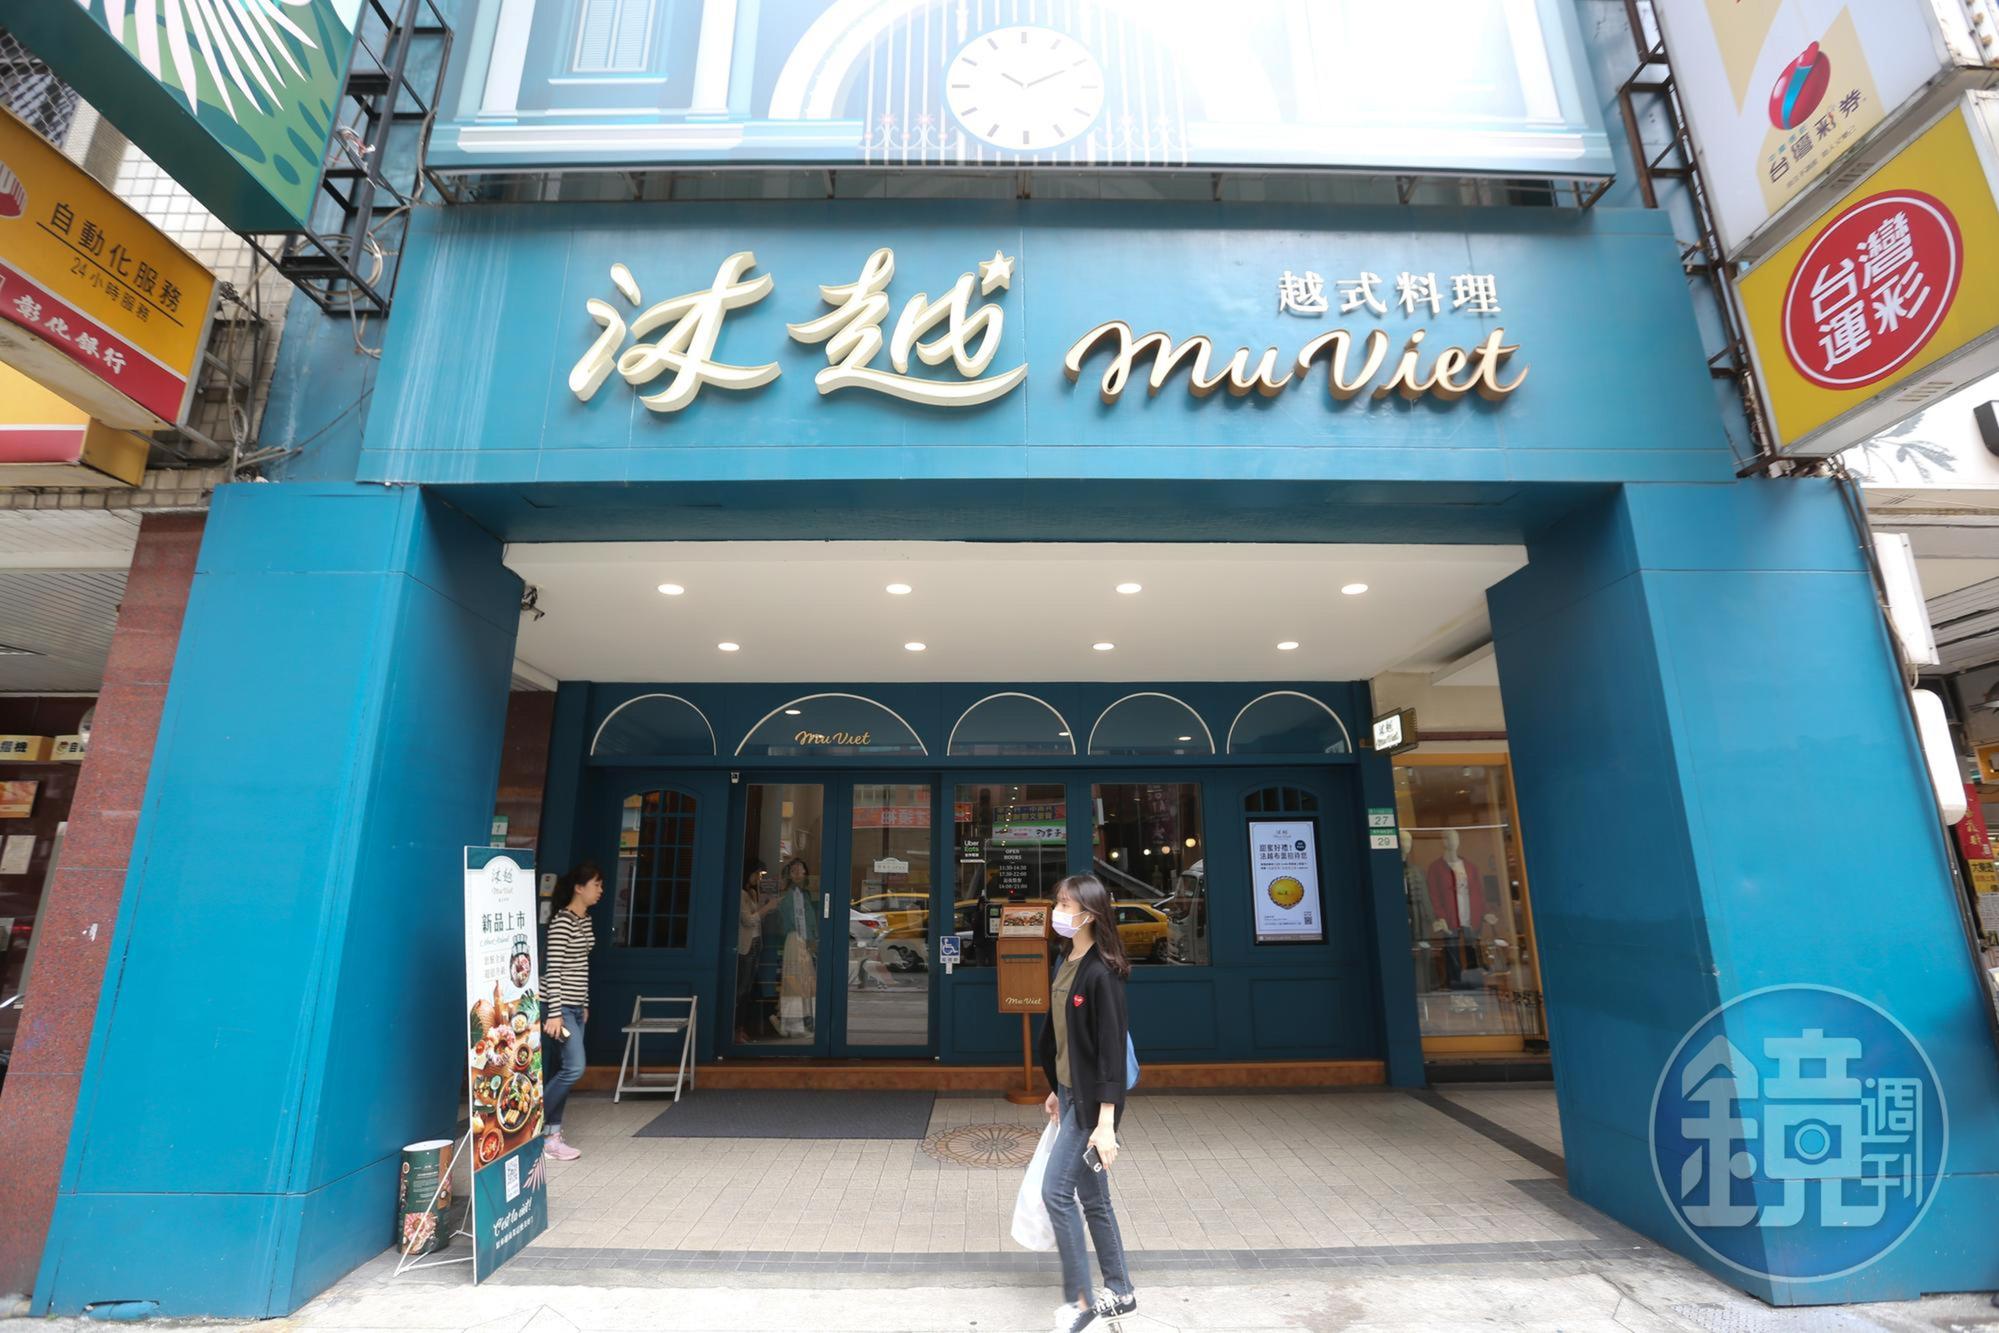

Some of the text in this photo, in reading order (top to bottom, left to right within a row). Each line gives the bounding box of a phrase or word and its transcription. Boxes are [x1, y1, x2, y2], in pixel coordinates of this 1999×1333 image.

[1768, 89, 1862, 184] 台灣彩券
[50, 203, 183, 313] 自動化服務
[70, 257, 151, 323] 24小時服務
[1277, 270, 1508, 317] 越式料理
[1809, 210, 1913, 323] 台灣
[13, 294, 129, 376] 彰化銀行
[1818, 261, 1931, 372] 運彩
[1295, 326, 1531, 404] Viet
[833, 731, 871, 745] Viet
[1374, 815, 1388, 825] 27
[482, 910, 526, 934] 新品上市
